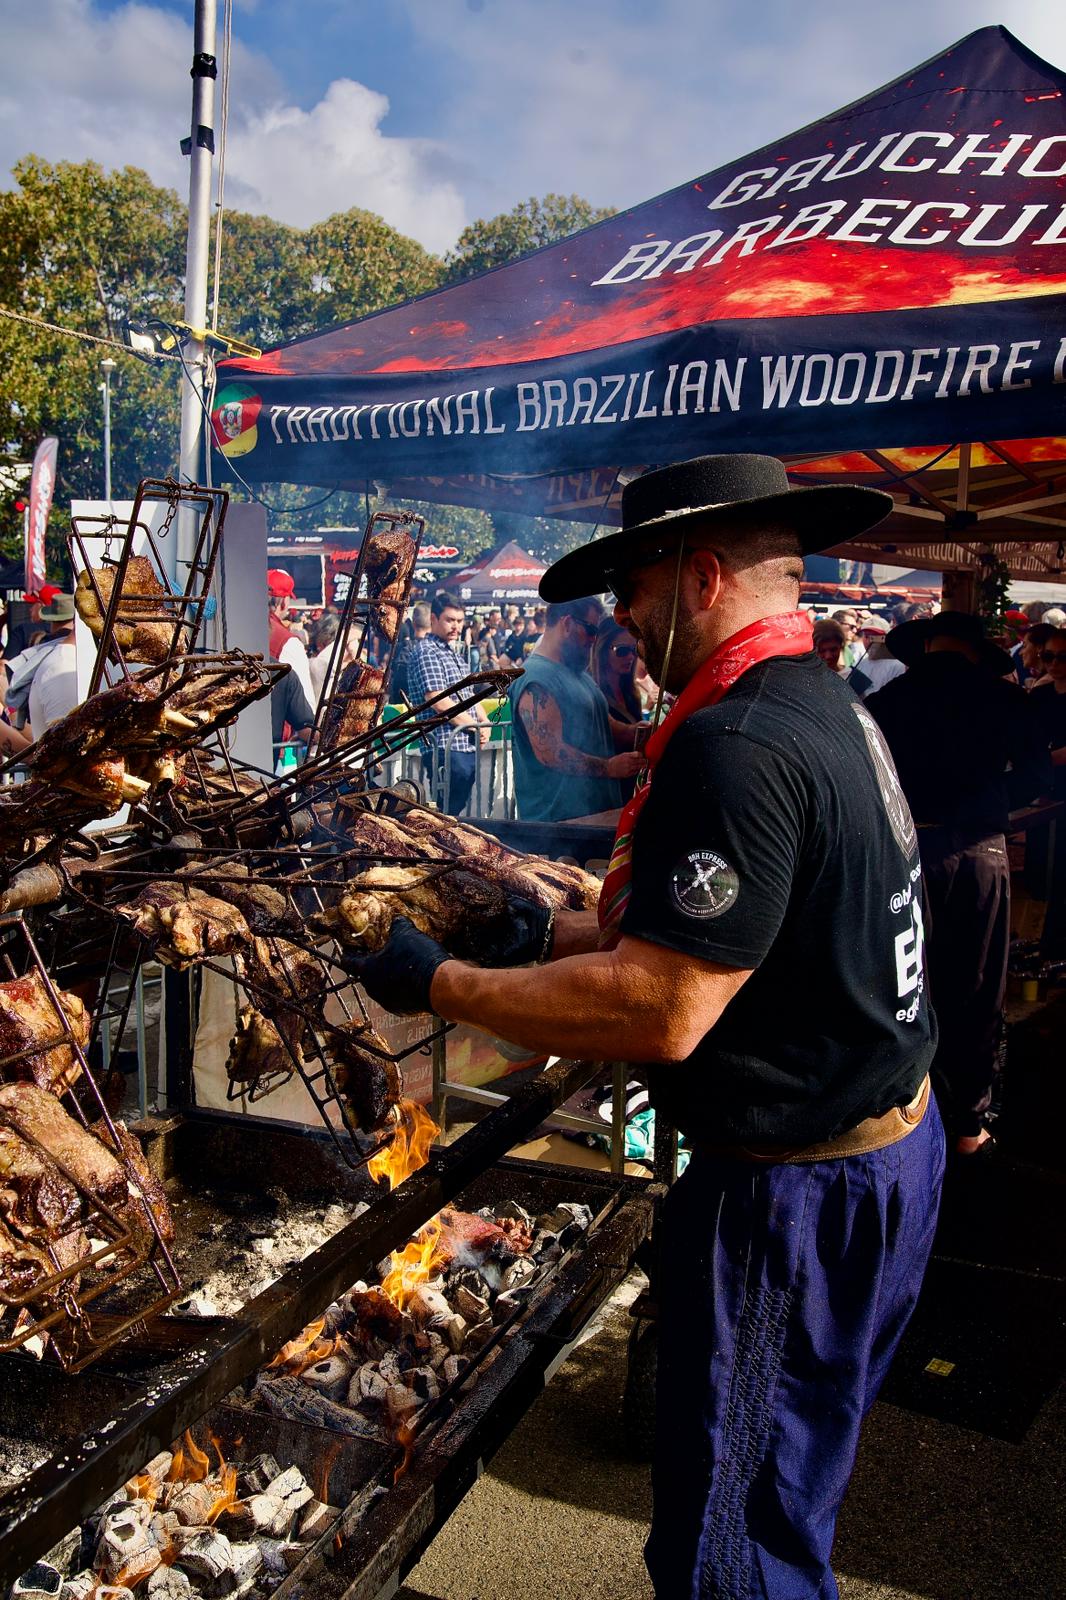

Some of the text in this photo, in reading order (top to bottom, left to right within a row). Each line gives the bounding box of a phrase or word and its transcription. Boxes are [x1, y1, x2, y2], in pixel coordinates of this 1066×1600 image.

[707, 131, 1066, 211] GAUCHO
[270, 387, 505, 444] TRADITIONAL
[516, 356, 747, 432] BRAZILIAN
[760, 340, 1041, 409] WOODFIRE
